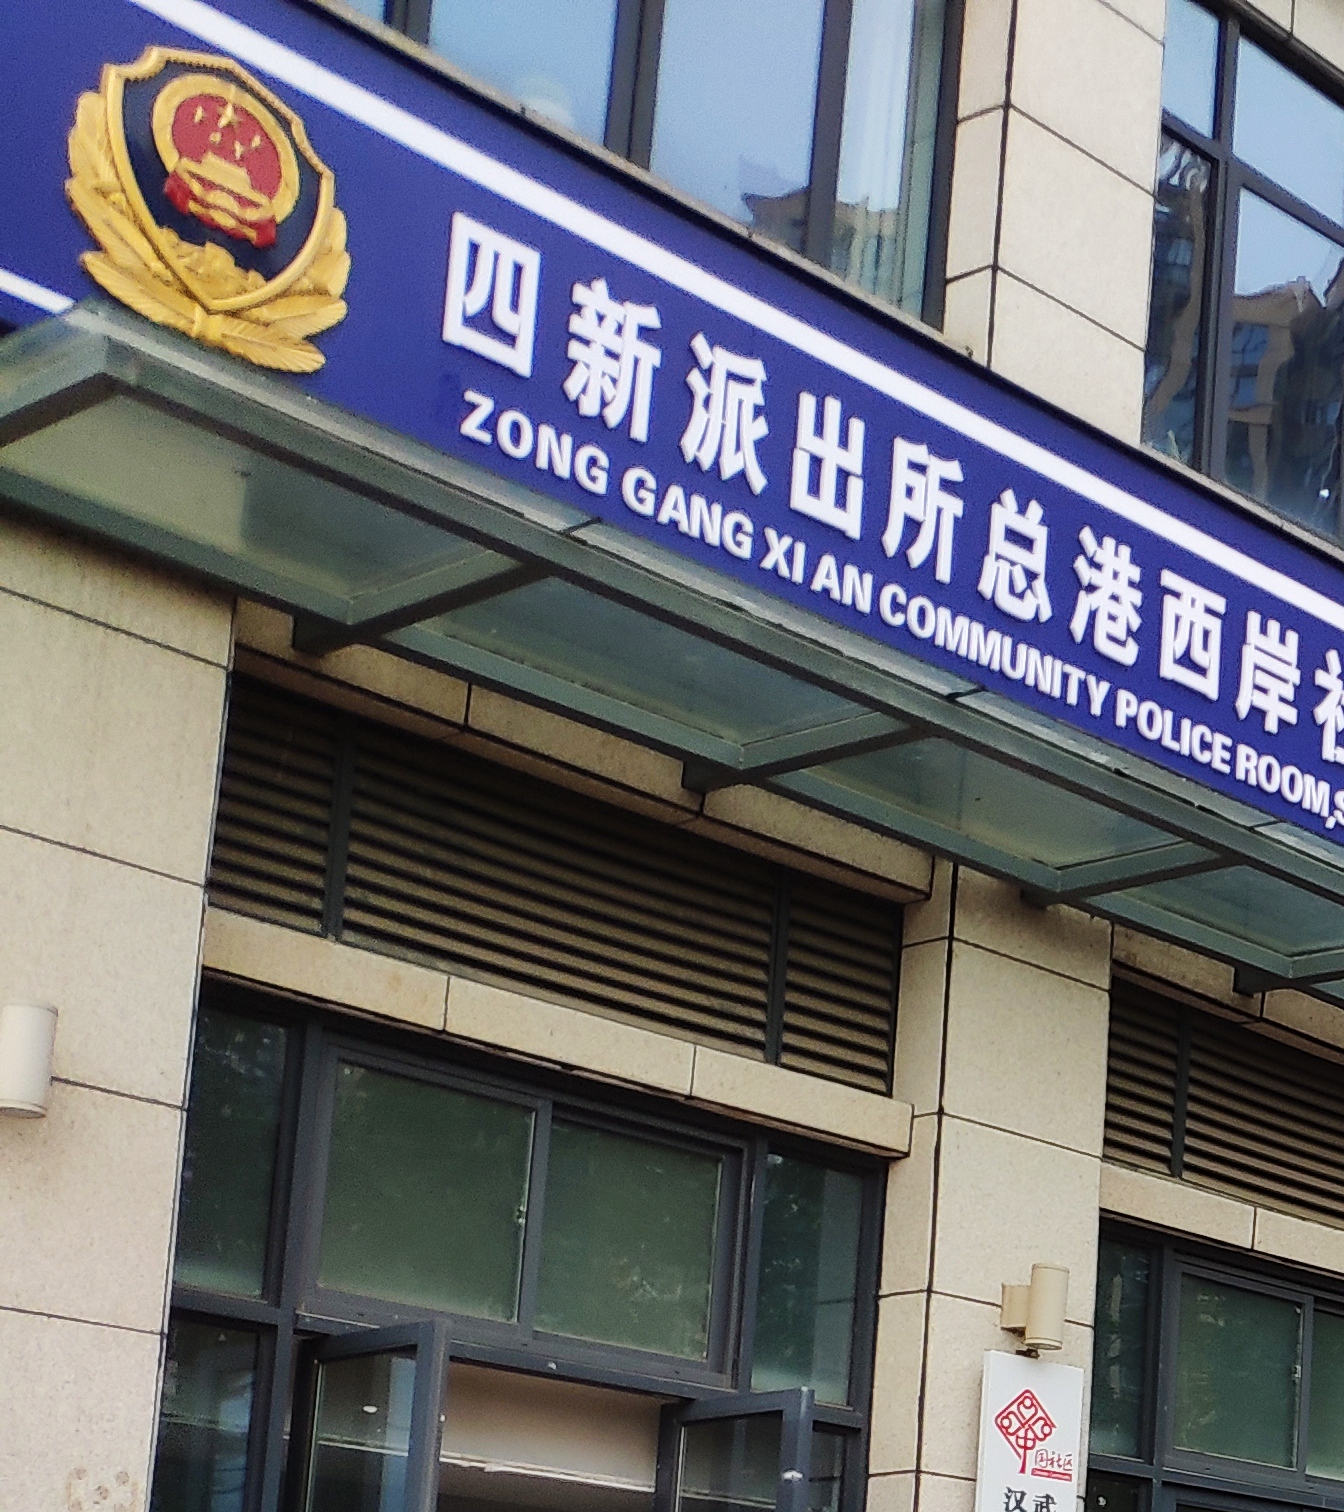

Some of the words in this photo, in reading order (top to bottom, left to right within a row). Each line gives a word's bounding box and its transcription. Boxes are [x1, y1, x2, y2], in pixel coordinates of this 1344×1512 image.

[460, 391, 608, 495] ZONG
[622, 466, 753, 561] GANG
[879, 581, 1110, 719] COMMUNITY
[1115, 688, 1232, 783] POLICE
